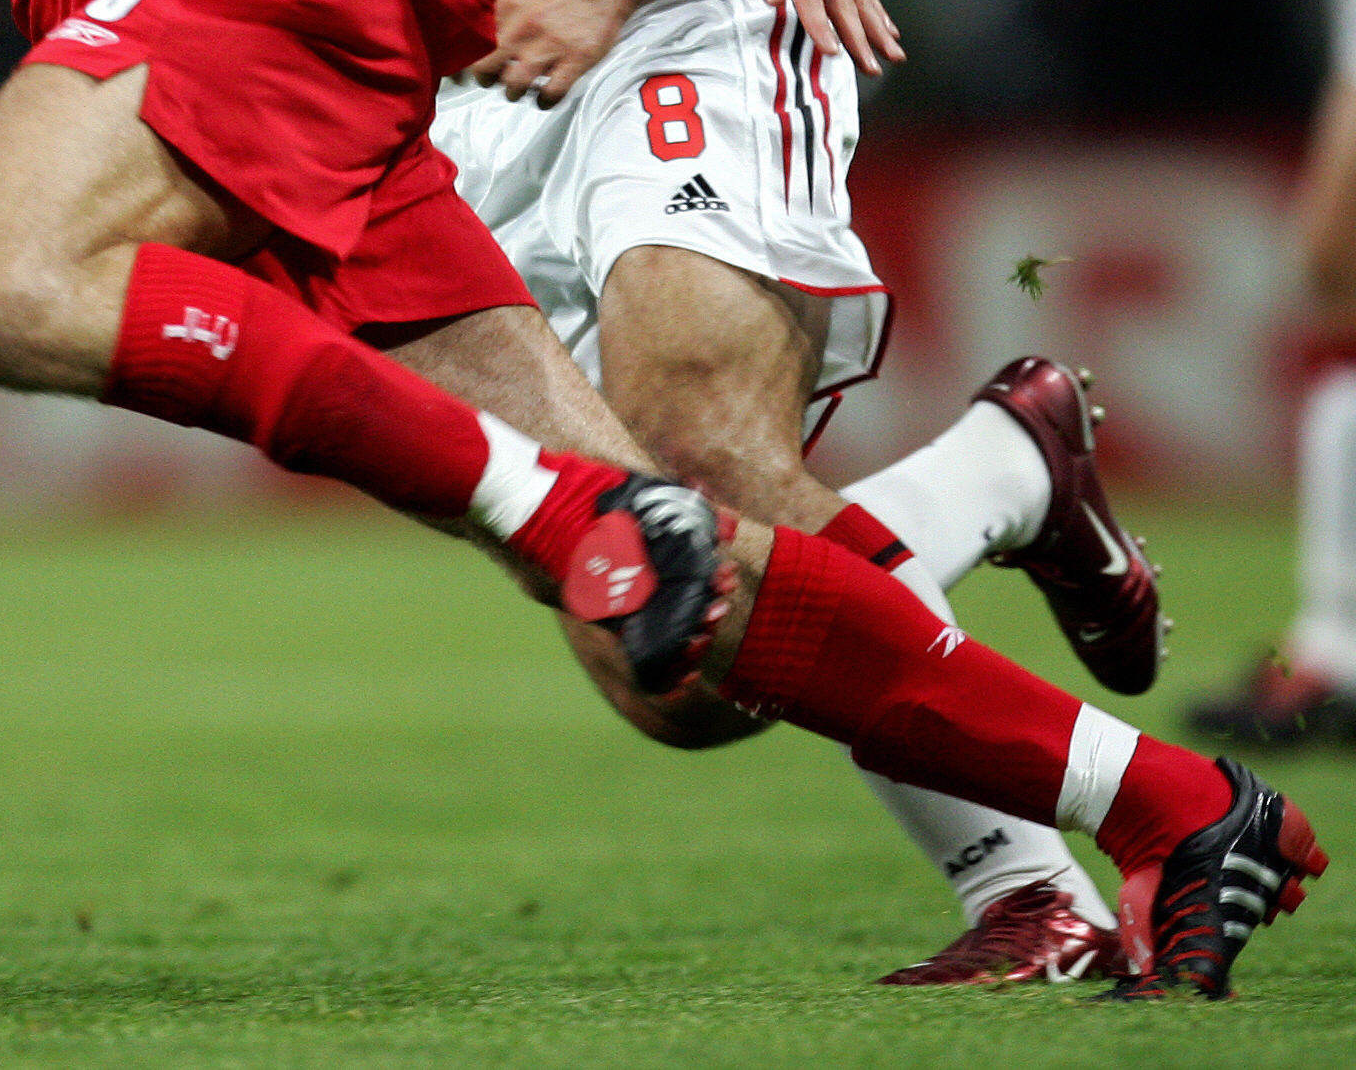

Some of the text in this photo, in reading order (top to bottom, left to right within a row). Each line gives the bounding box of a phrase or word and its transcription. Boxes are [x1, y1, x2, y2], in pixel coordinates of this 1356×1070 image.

[639, 73, 706, 162] 8
[664, 196, 730, 215] adidas
[946, 827, 1011, 878] ACM
